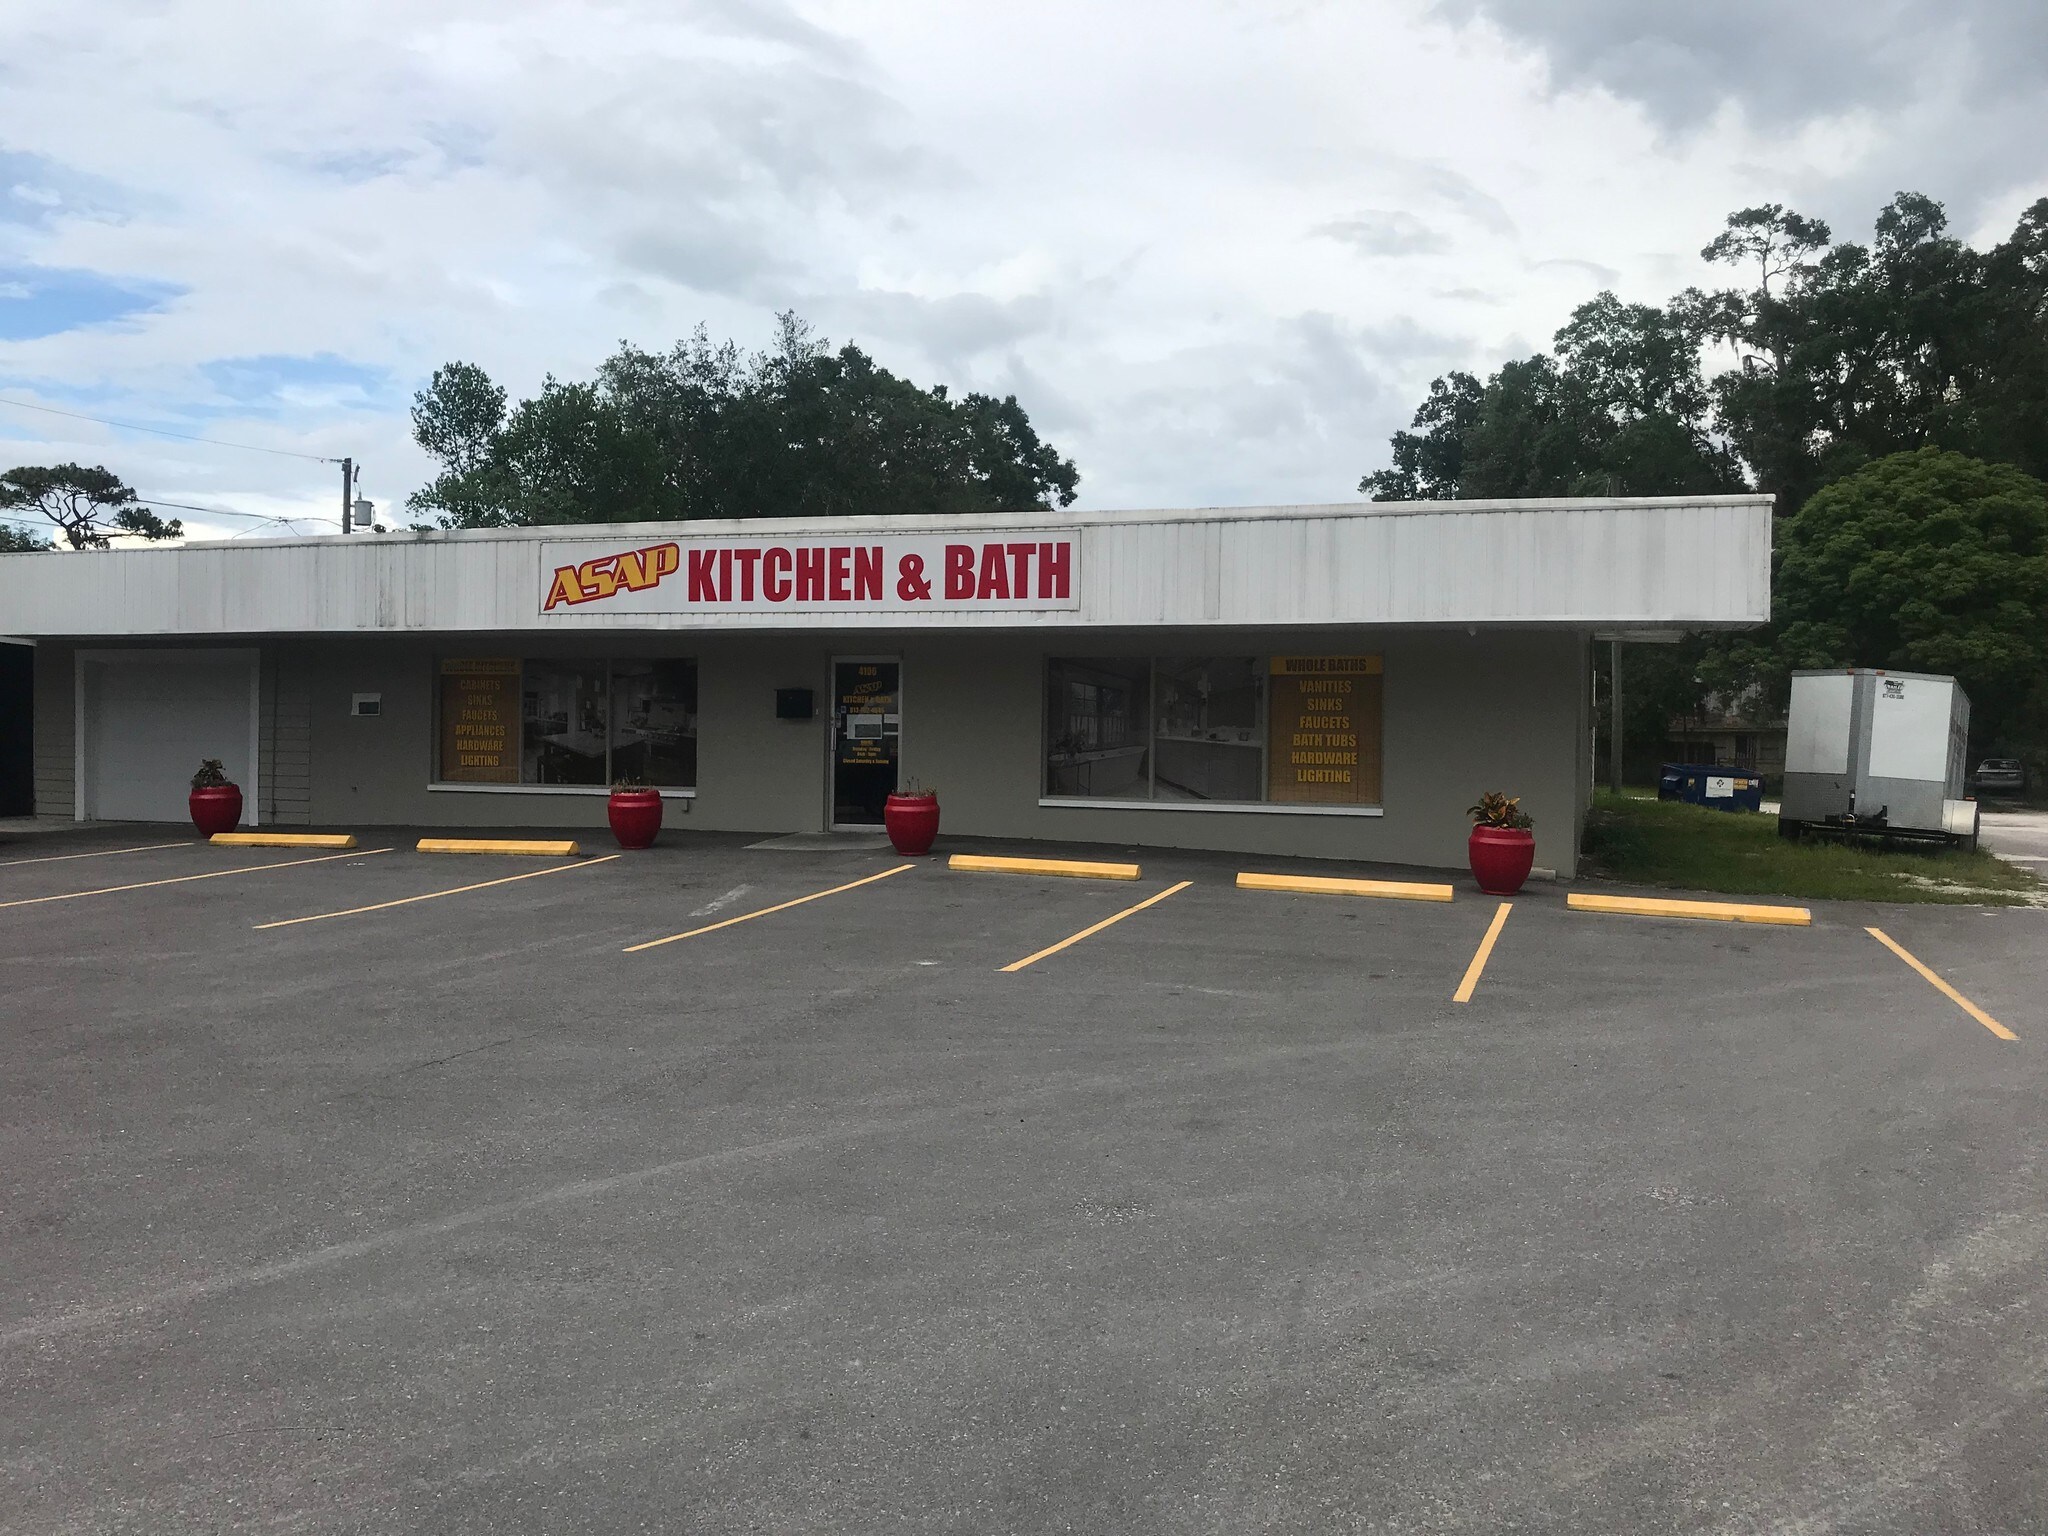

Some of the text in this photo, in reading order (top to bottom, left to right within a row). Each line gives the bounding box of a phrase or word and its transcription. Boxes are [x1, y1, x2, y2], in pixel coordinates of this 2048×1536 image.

[543, 542, 1071, 611] ASAP KITCHEN & BATH
[1286, 659, 1367, 672] WHOLE BATHS
[460, 679, 501, 691] CABINETS
[1299, 680, 1352, 693] VANITIES
[467, 694, 493, 706] SINKS
[1307, 698, 1343, 711] SINKS
[462, 710, 498, 721] FAUCETS
[1299, 716, 1350, 729] FAUCETS
[455, 725, 505, 736] APPLIANCES
[456, 740, 504, 751] HARDWARE
[1293, 734, 1357, 747] BATH TUBS
[460, 755, 499, 767] LIGHTING
[1291, 752, 1358, 765] HARDWARE
[1297, 769, 1351, 783] LIGHTING
